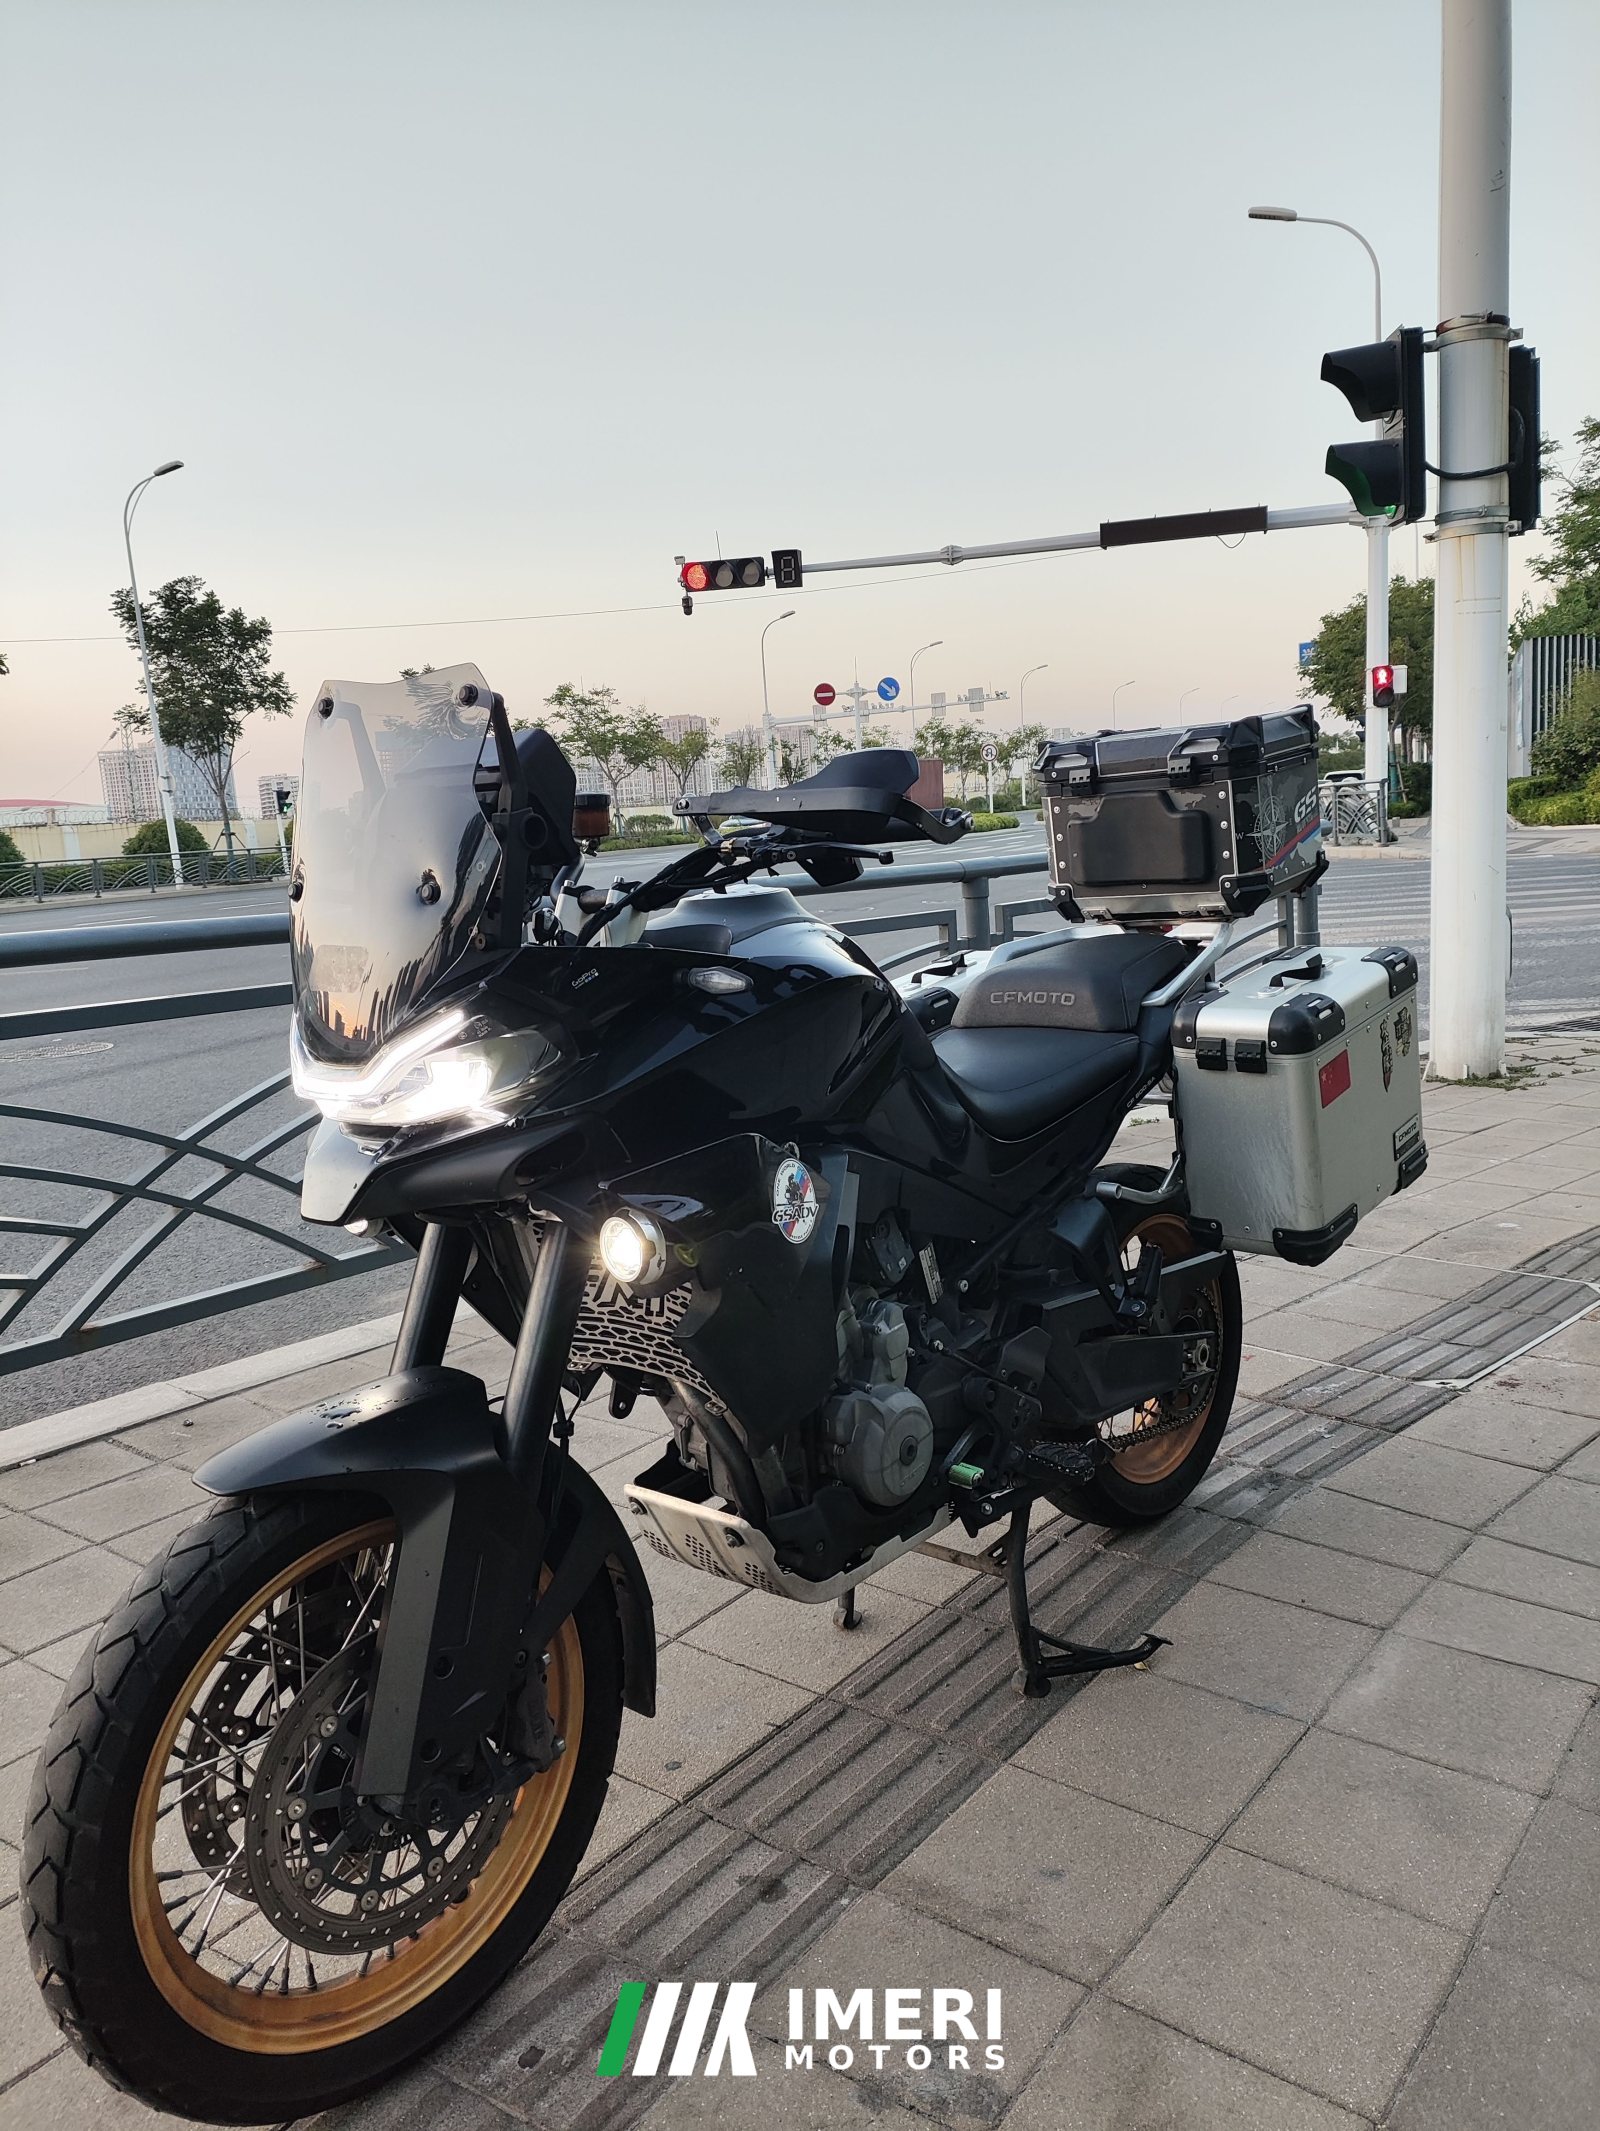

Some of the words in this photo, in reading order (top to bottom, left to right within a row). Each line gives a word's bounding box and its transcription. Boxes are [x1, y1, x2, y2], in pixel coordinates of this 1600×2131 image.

[1294, 785, 1317, 824] GS
[571, 968, 597, 987] GoPro
[990, 991, 1075, 1006] CFMOTO
[773, 1205, 818, 1222] GSADV
